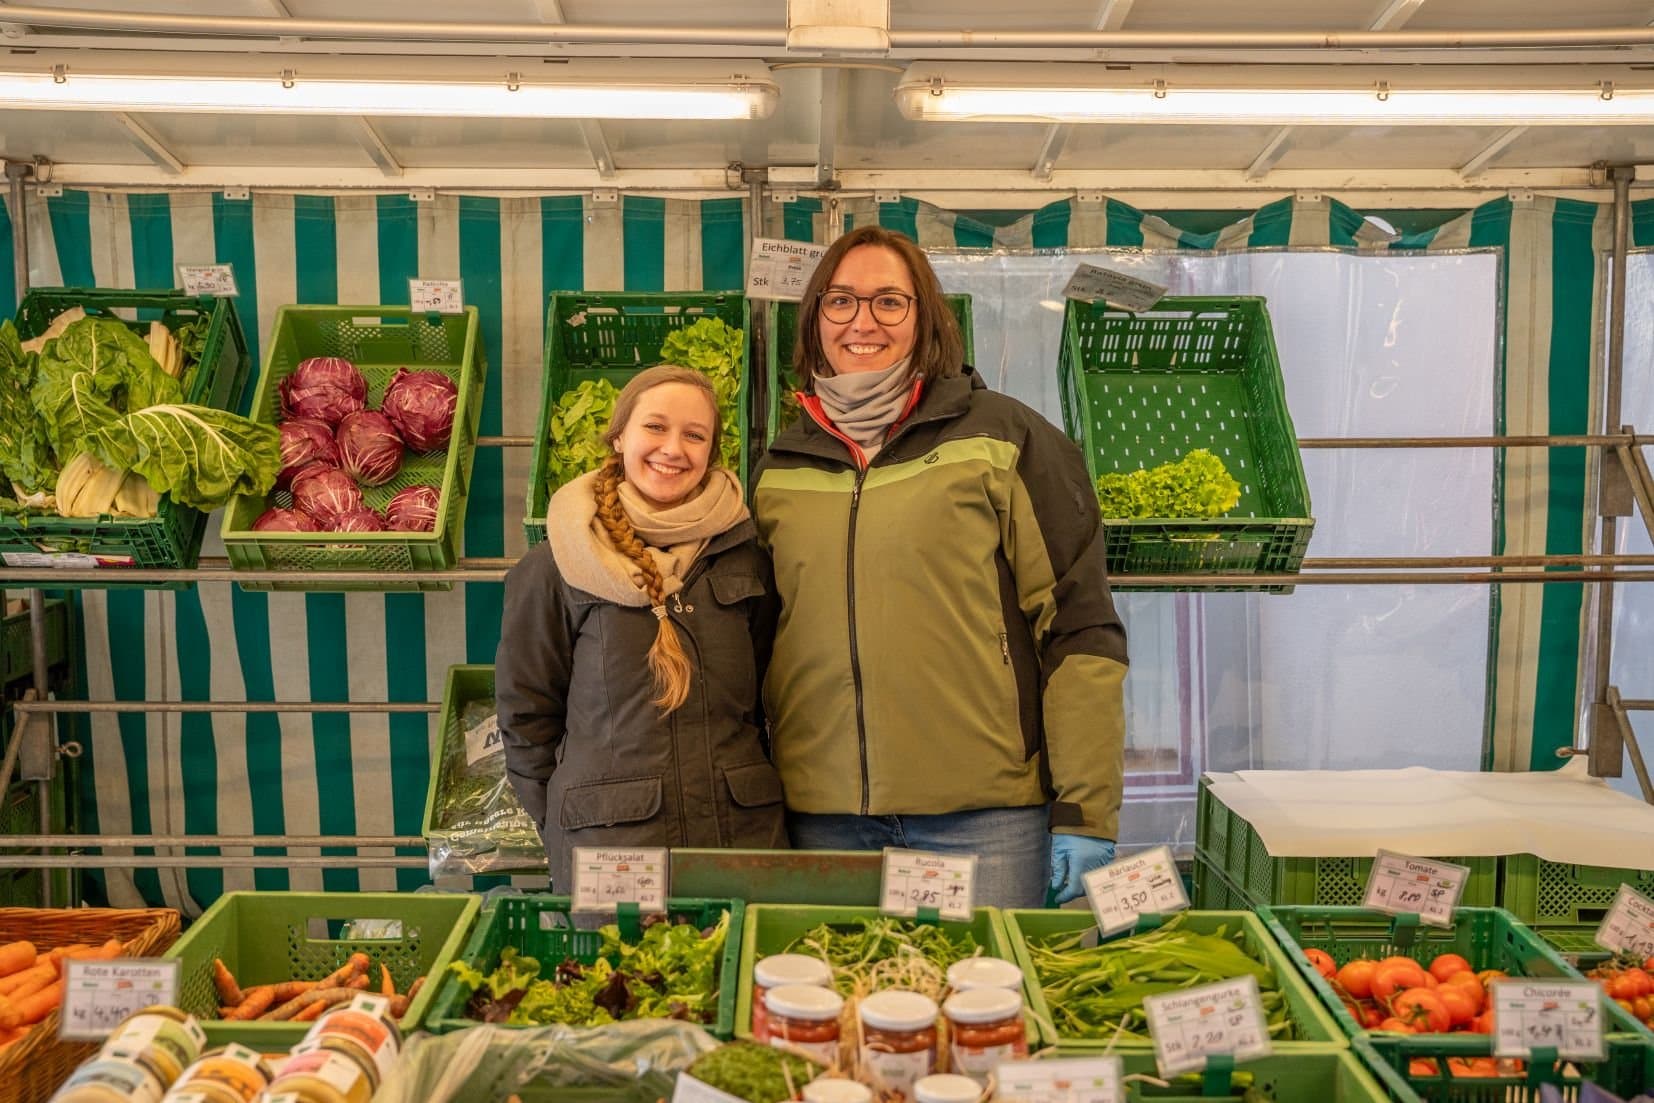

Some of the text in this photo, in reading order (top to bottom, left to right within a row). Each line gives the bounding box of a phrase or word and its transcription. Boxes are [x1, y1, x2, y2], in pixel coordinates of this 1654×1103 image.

[762, 242, 807, 255] Eichblatt
[752, 277, 769, 287] Stk
[915, 857, 945, 868] Rucola
[1404, 860, 1438, 875] Tomate
[1121, 890, 1148, 911] 3,50
[1628, 897, 1654, 918] Cockta
[83, 966, 161, 977] Rote Karotten
[1523, 986, 1572, 998] Chicorée
[1165, 1041, 1183, 1053] Stk
